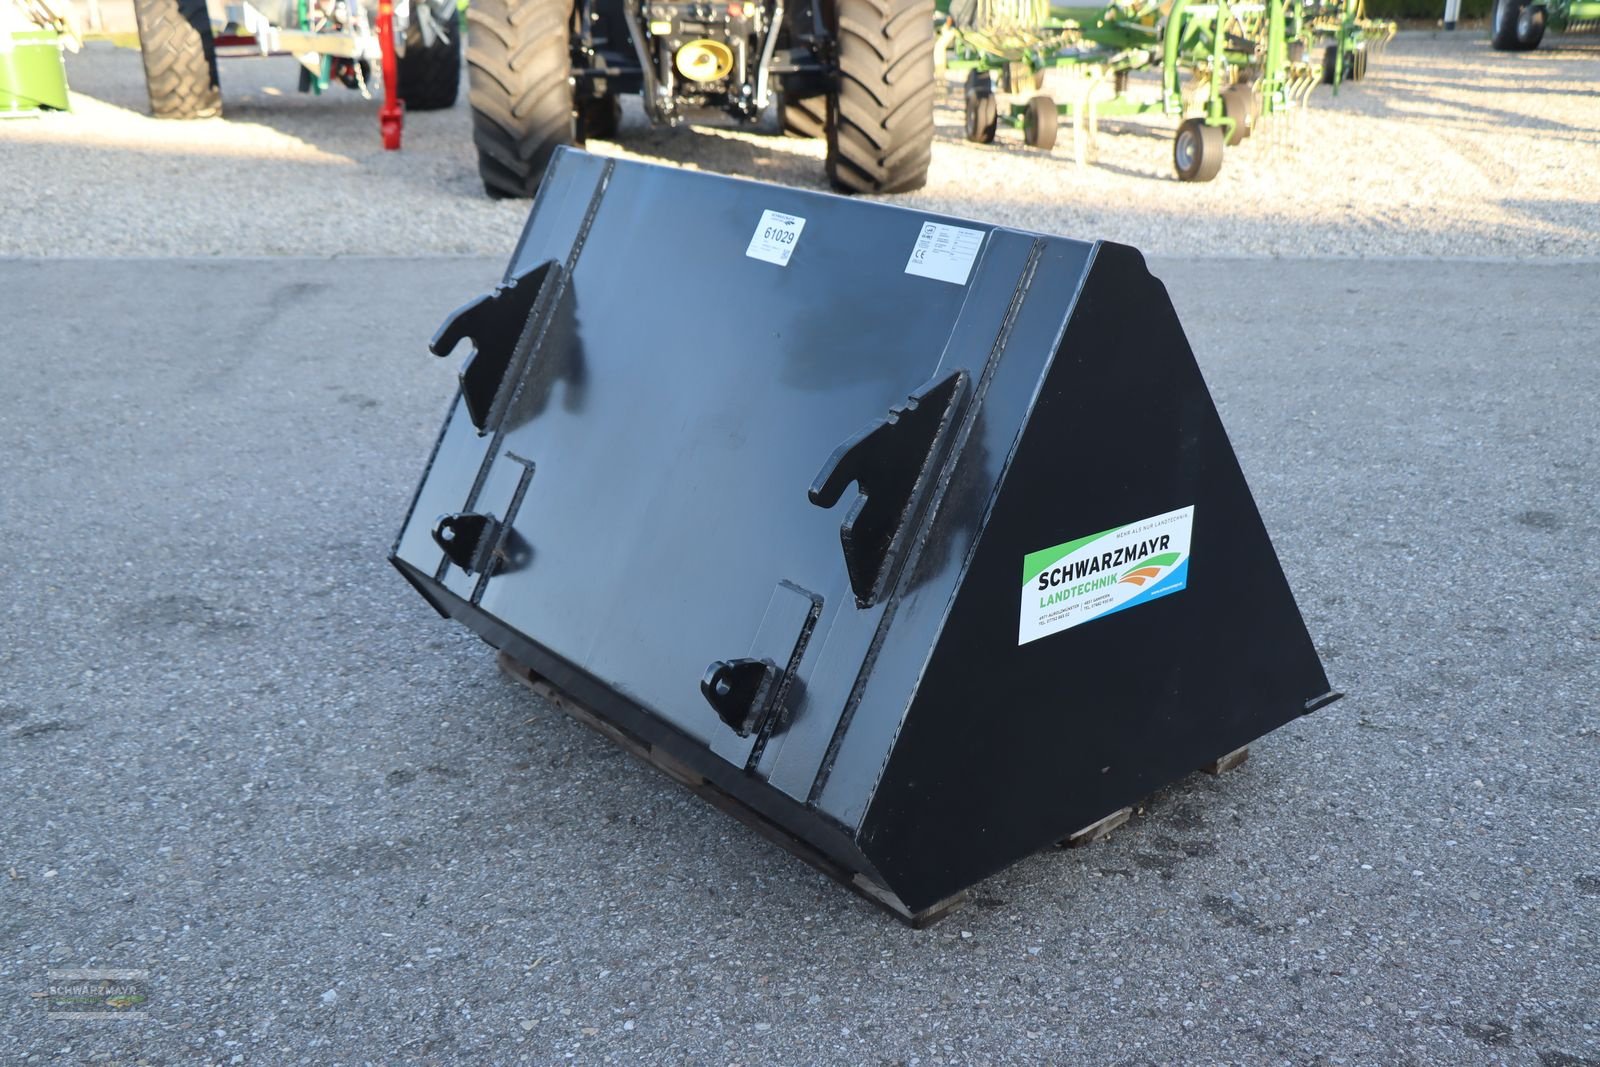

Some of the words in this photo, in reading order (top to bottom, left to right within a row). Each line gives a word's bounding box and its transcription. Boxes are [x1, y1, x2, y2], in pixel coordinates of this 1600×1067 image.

[764, 227, 795, 245] 61029
[915, 249, 927, 260] CE
[1116, 531, 1130, 539] MEHR
[1143, 523, 1154, 531] NUR
[1154, 513, 1188, 528] LANDTECHNIK
[1038, 534, 1170, 591] SCHWARZMAYR
[1039, 573, 1118, 609] LANDTECHNIK
